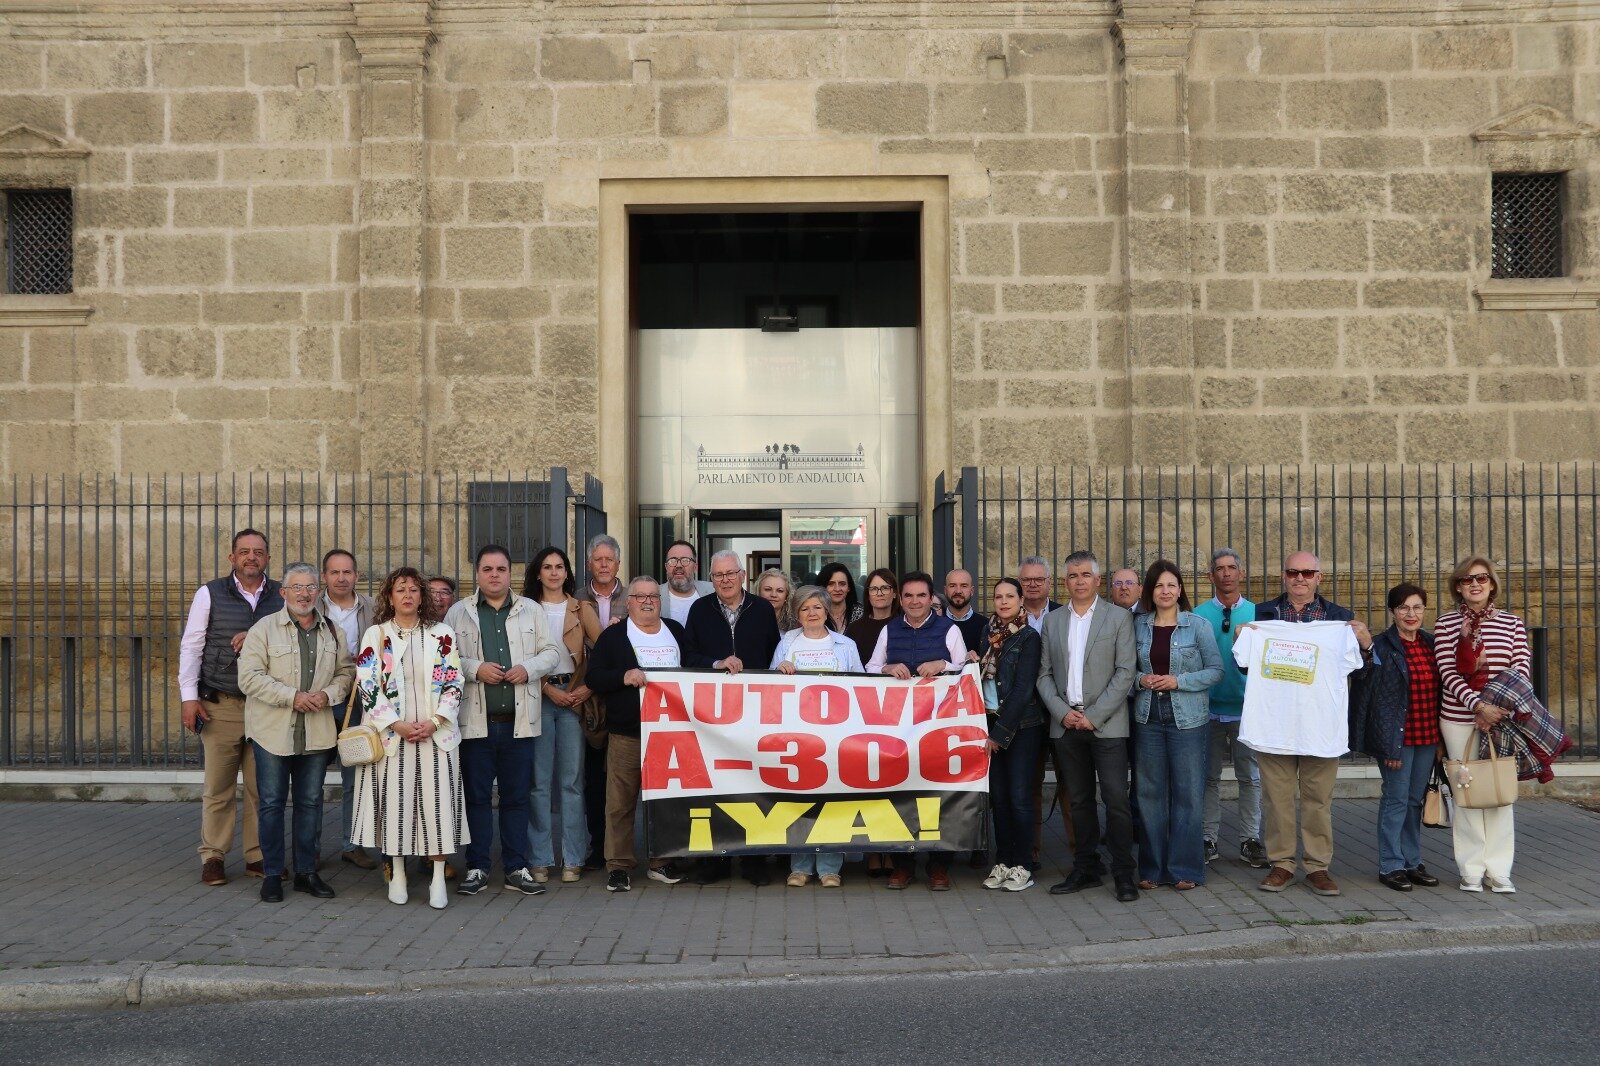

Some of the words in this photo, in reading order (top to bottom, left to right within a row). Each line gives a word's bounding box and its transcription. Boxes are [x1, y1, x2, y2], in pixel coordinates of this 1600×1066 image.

[698, 473, 776, 483] PARLAMENTO
[778, 473, 794, 483] DE
[796, 473, 865, 483] ANDALUCIA
[641, 673, 985, 726] AUTOVÍA
[642, 725, 989, 791] A-306
[689, 797, 941, 852] ¡YA!
